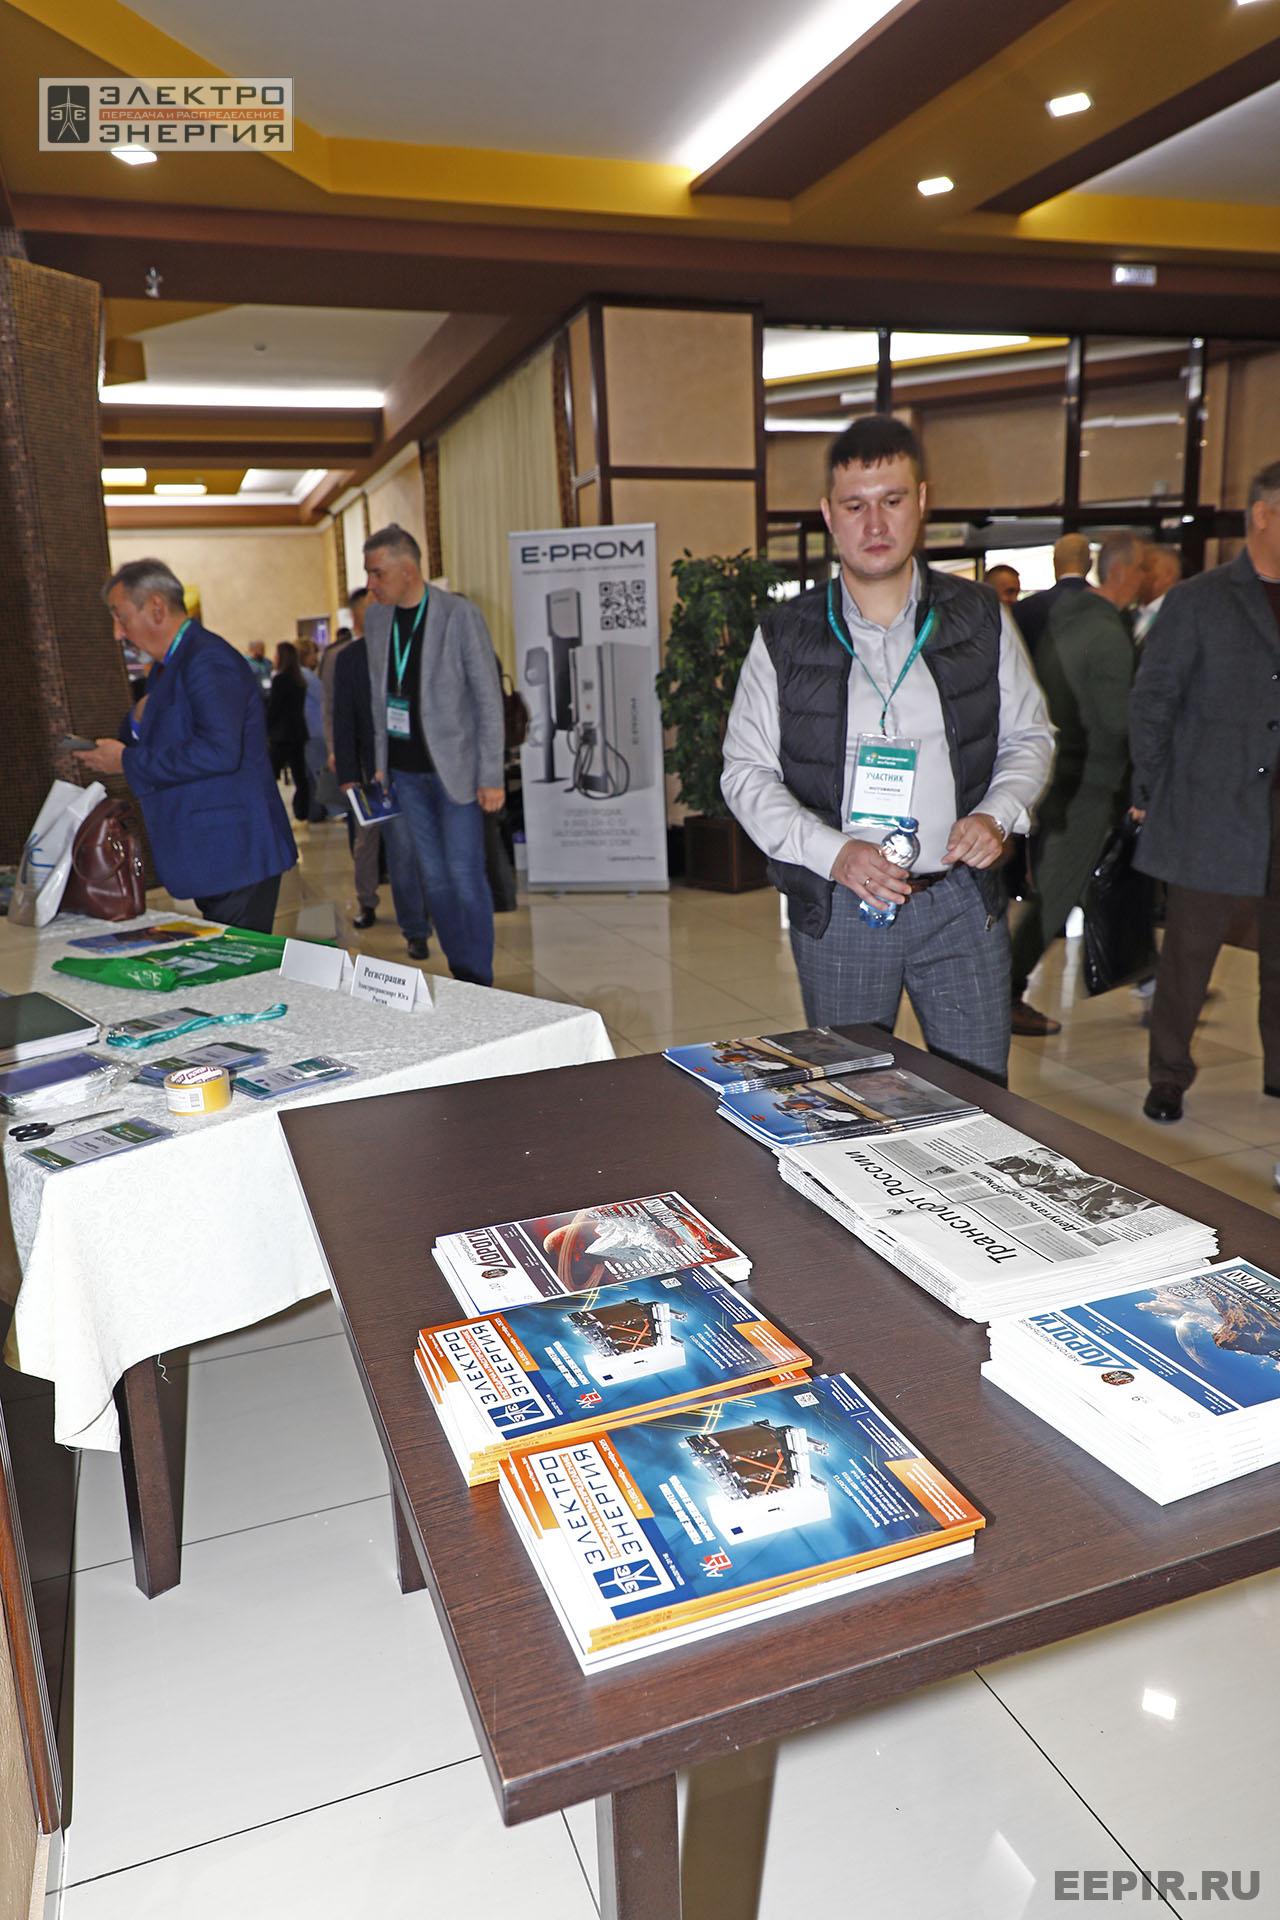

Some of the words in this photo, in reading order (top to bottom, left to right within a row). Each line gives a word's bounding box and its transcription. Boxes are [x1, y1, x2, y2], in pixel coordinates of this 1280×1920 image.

[521, 539, 644, 564] E-PROM
[866, 771, 904, 783] УЧАСТНИК
[364, 967, 406, 986] Регистрация
[845, 1151, 914, 1197] России
[1025, 1200, 1080, 1232] Депутаты
[444, 1331, 498, 1404] ЭЛЕКТРО
[472, 1324, 530, 1397] ЭНЕРГИЯ
[539, 1456, 605, 1564] ЭЛЕКТРО
[573, 1448, 643, 1555] ЭНЕРГИЯ
[594, 1518, 619, 1557] ПЕРЕДАЧА
